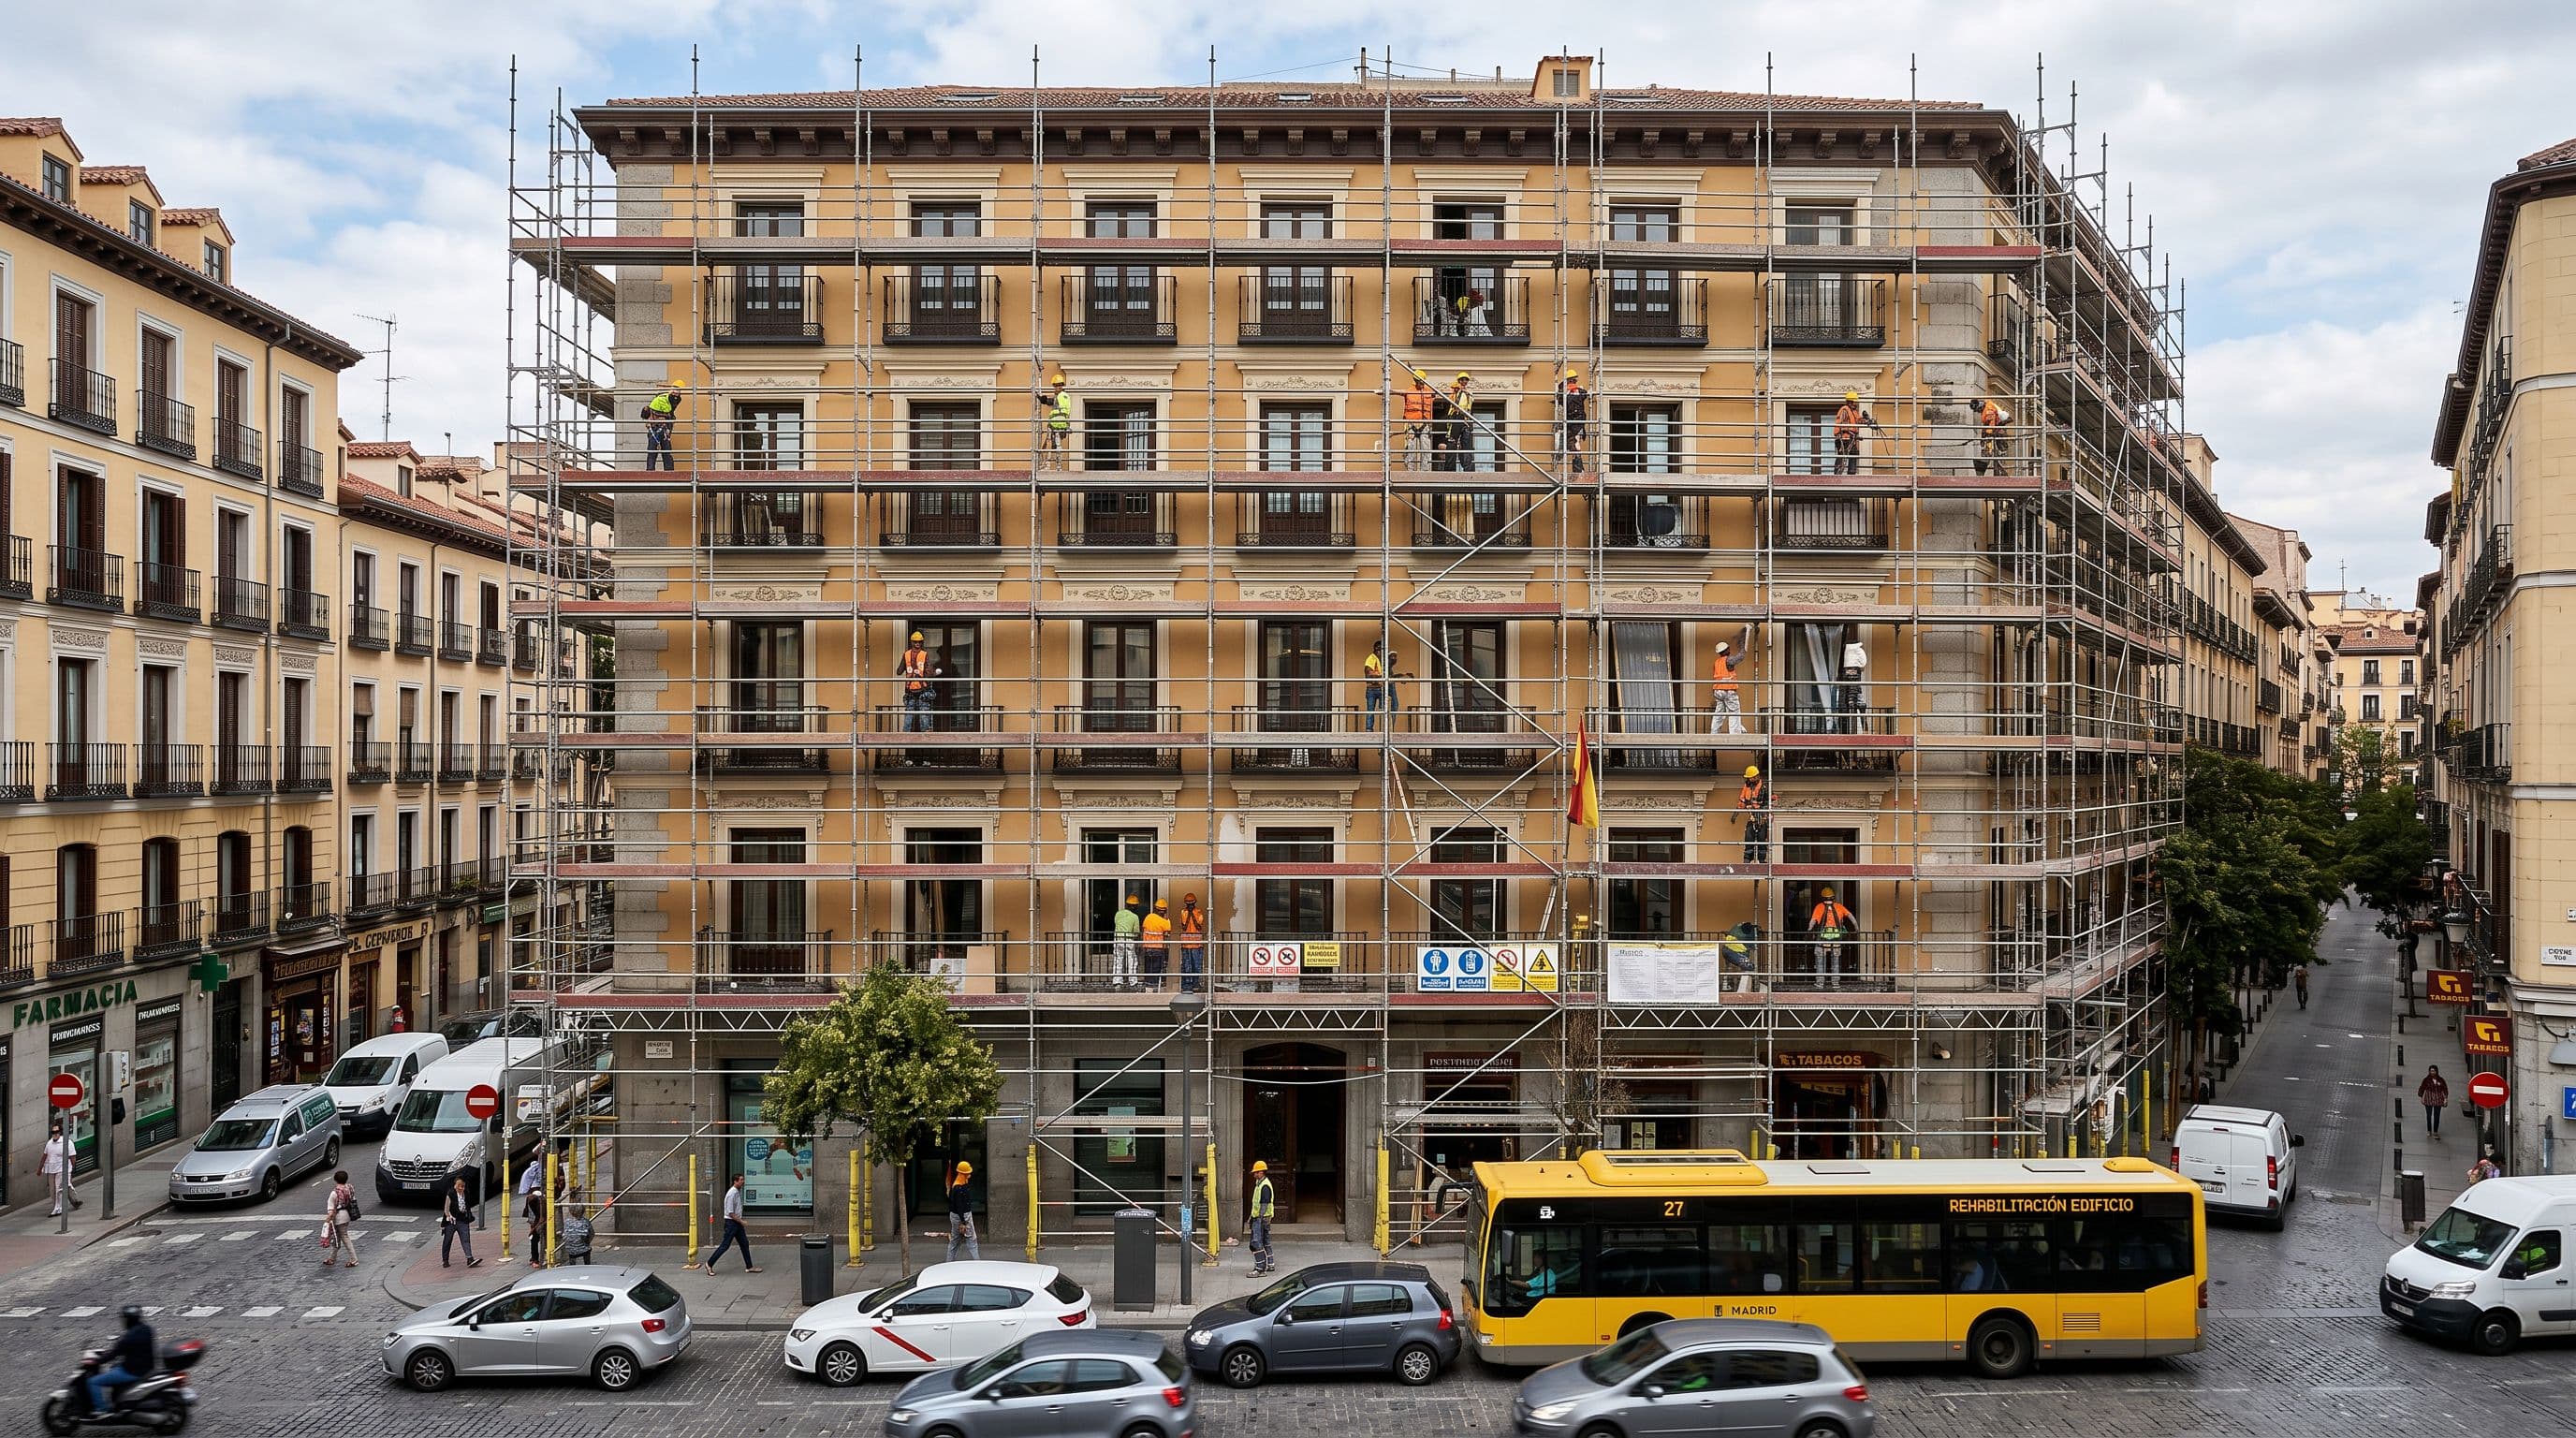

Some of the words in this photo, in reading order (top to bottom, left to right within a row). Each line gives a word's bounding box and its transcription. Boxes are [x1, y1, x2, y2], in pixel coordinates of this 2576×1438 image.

[13, 979, 138, 1029] FARMACIA
[1797, 1054, 1862, 1065] TABACOS
[1663, 1201, 1685, 1217] 27
[1950, 1196, 2066, 1212] REHABILITACIÓN
[2071, 1197, 2134, 1212] EDIFICIO
[1732, 1306, 1777, 1315] MADRID
